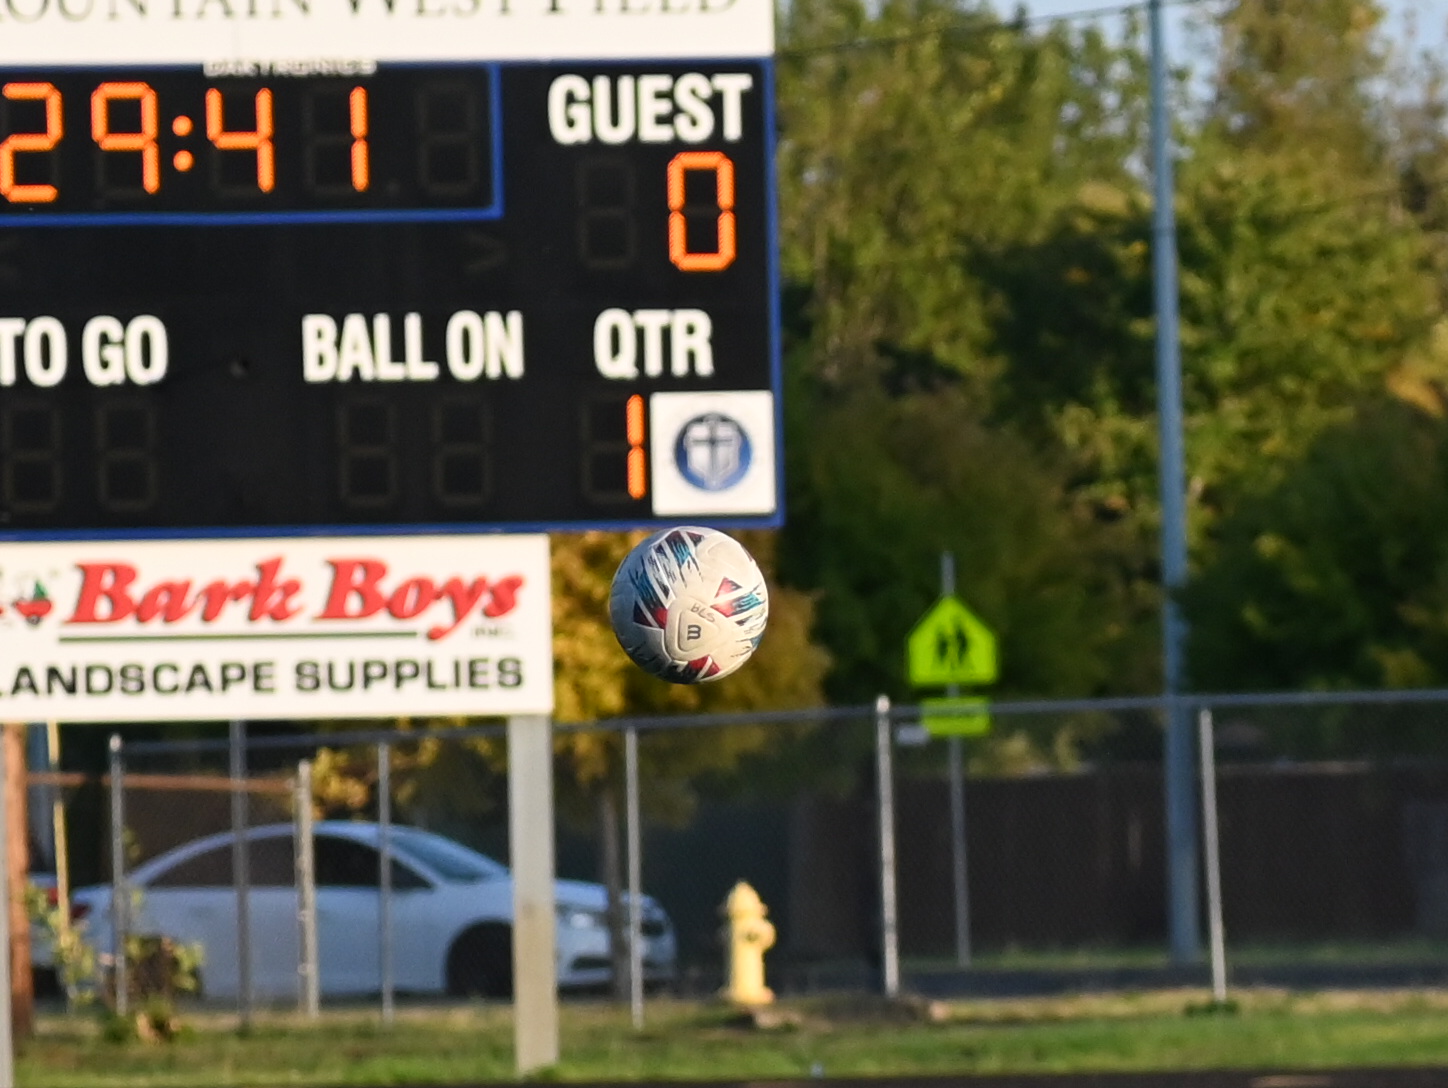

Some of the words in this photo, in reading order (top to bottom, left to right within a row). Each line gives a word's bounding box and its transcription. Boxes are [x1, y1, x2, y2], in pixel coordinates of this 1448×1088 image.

[0, 81, 369, 203] 29:41
[547, 72, 754, 145] GUEST
[666, 150, 736, 272] 0
[0, 314, 68, 387] TO
[82, 313, 170, 387] GO
[302, 312, 438, 383] BALL
[446, 310, 525, 380] ON
[593, 308, 715, 380] QTR
[626, 394, 645, 500] 1
[62, 554, 304, 624] Bark
[311, 556, 525, 642] Boys
[0, 661, 276, 697] ANDSCAPE
[294, 656, 524, 693] SUPPLIES
